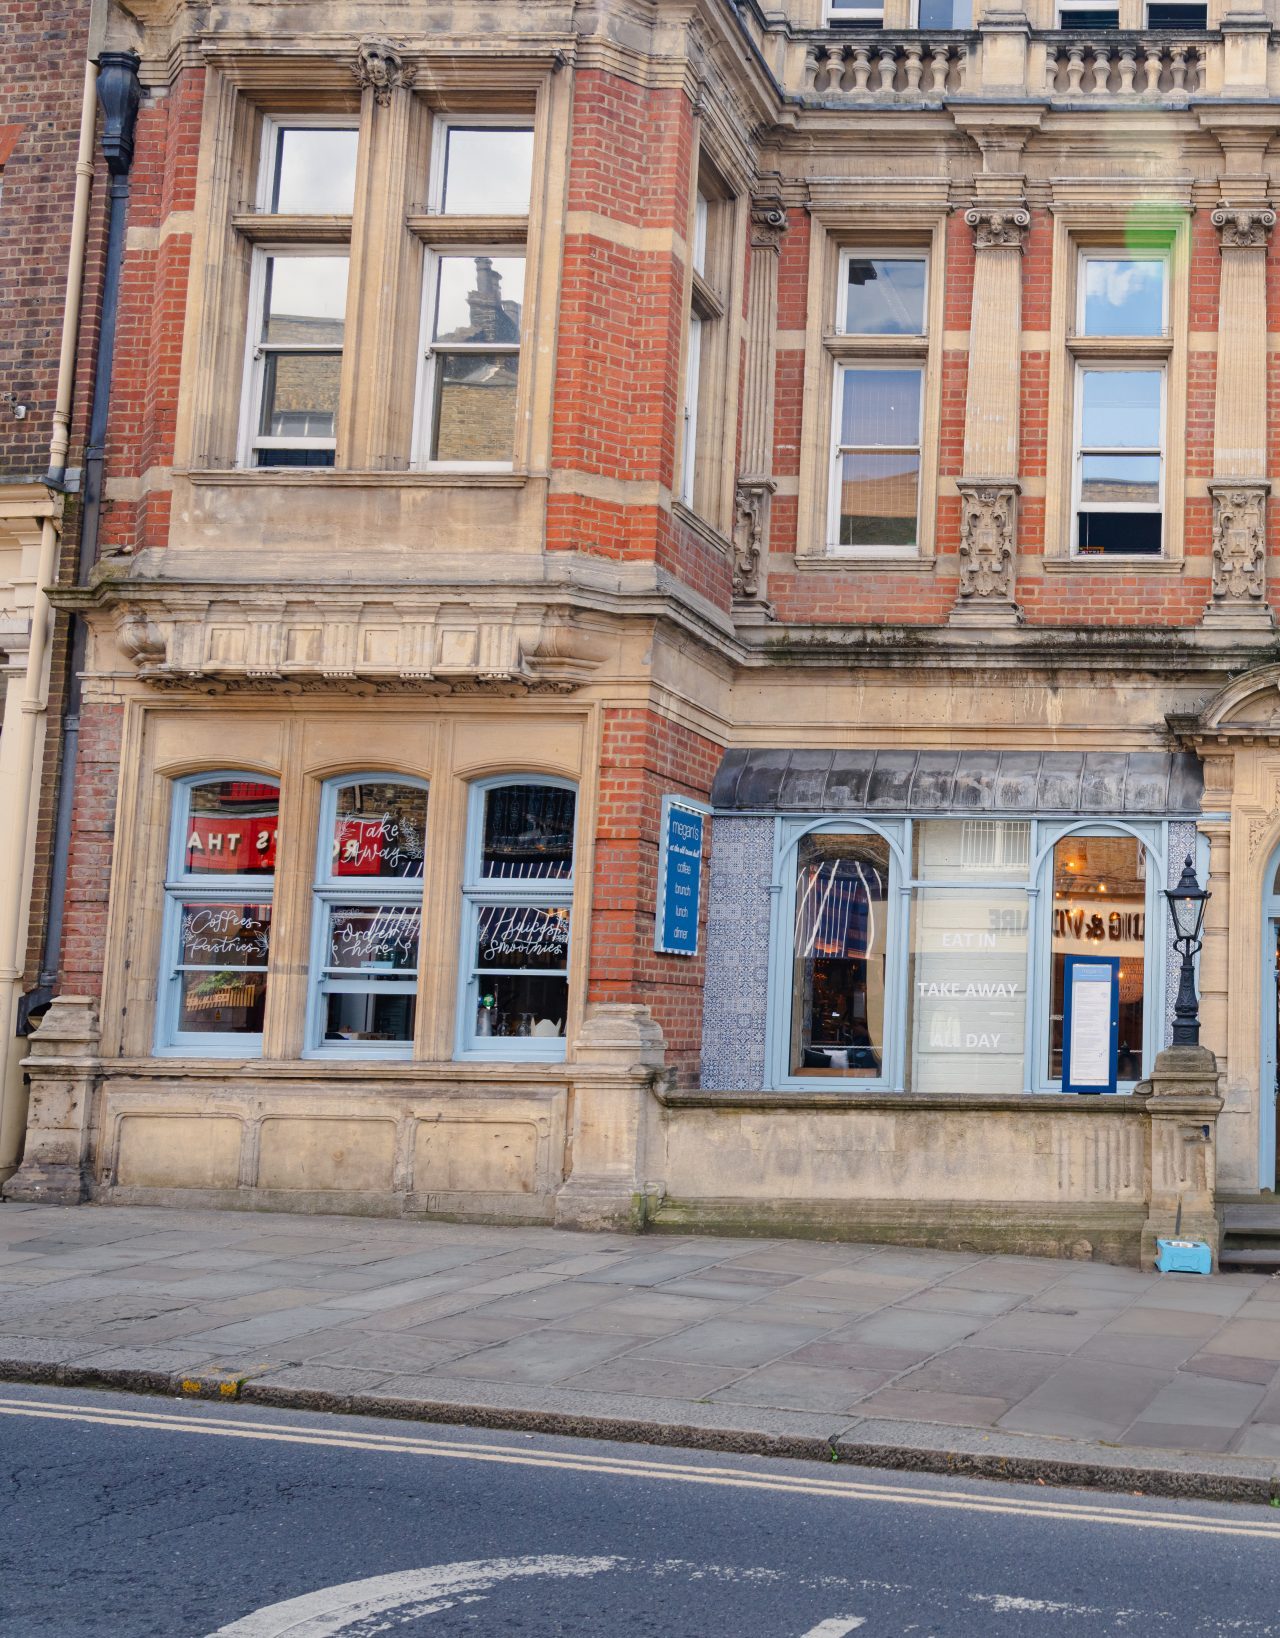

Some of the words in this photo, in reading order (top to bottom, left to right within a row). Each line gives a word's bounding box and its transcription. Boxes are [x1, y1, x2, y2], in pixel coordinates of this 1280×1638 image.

[353, 812, 399, 843] Take
[671, 820, 699, 841] megan's
[341, 841, 408, 867] Away
[676, 861, 692, 875] coffee
[674, 882, 691, 897] brunch
[675, 904, 689, 918] lunch
[190, 909, 261, 934] Coffees
[673, 926, 689, 940] dinner
[942, 933, 974, 947] EAT
[979, 933, 996, 947] IN
[186, 936, 260, 958] Pastries
[343, 940, 393, 956] here
[484, 937, 562, 960] Smoothies
[918, 982, 960, 997] TAKE
[964, 983, 1018, 998] AWAY
[932, 1033, 960, 1048] ALL
[967, 1033, 1001, 1048] DAY
